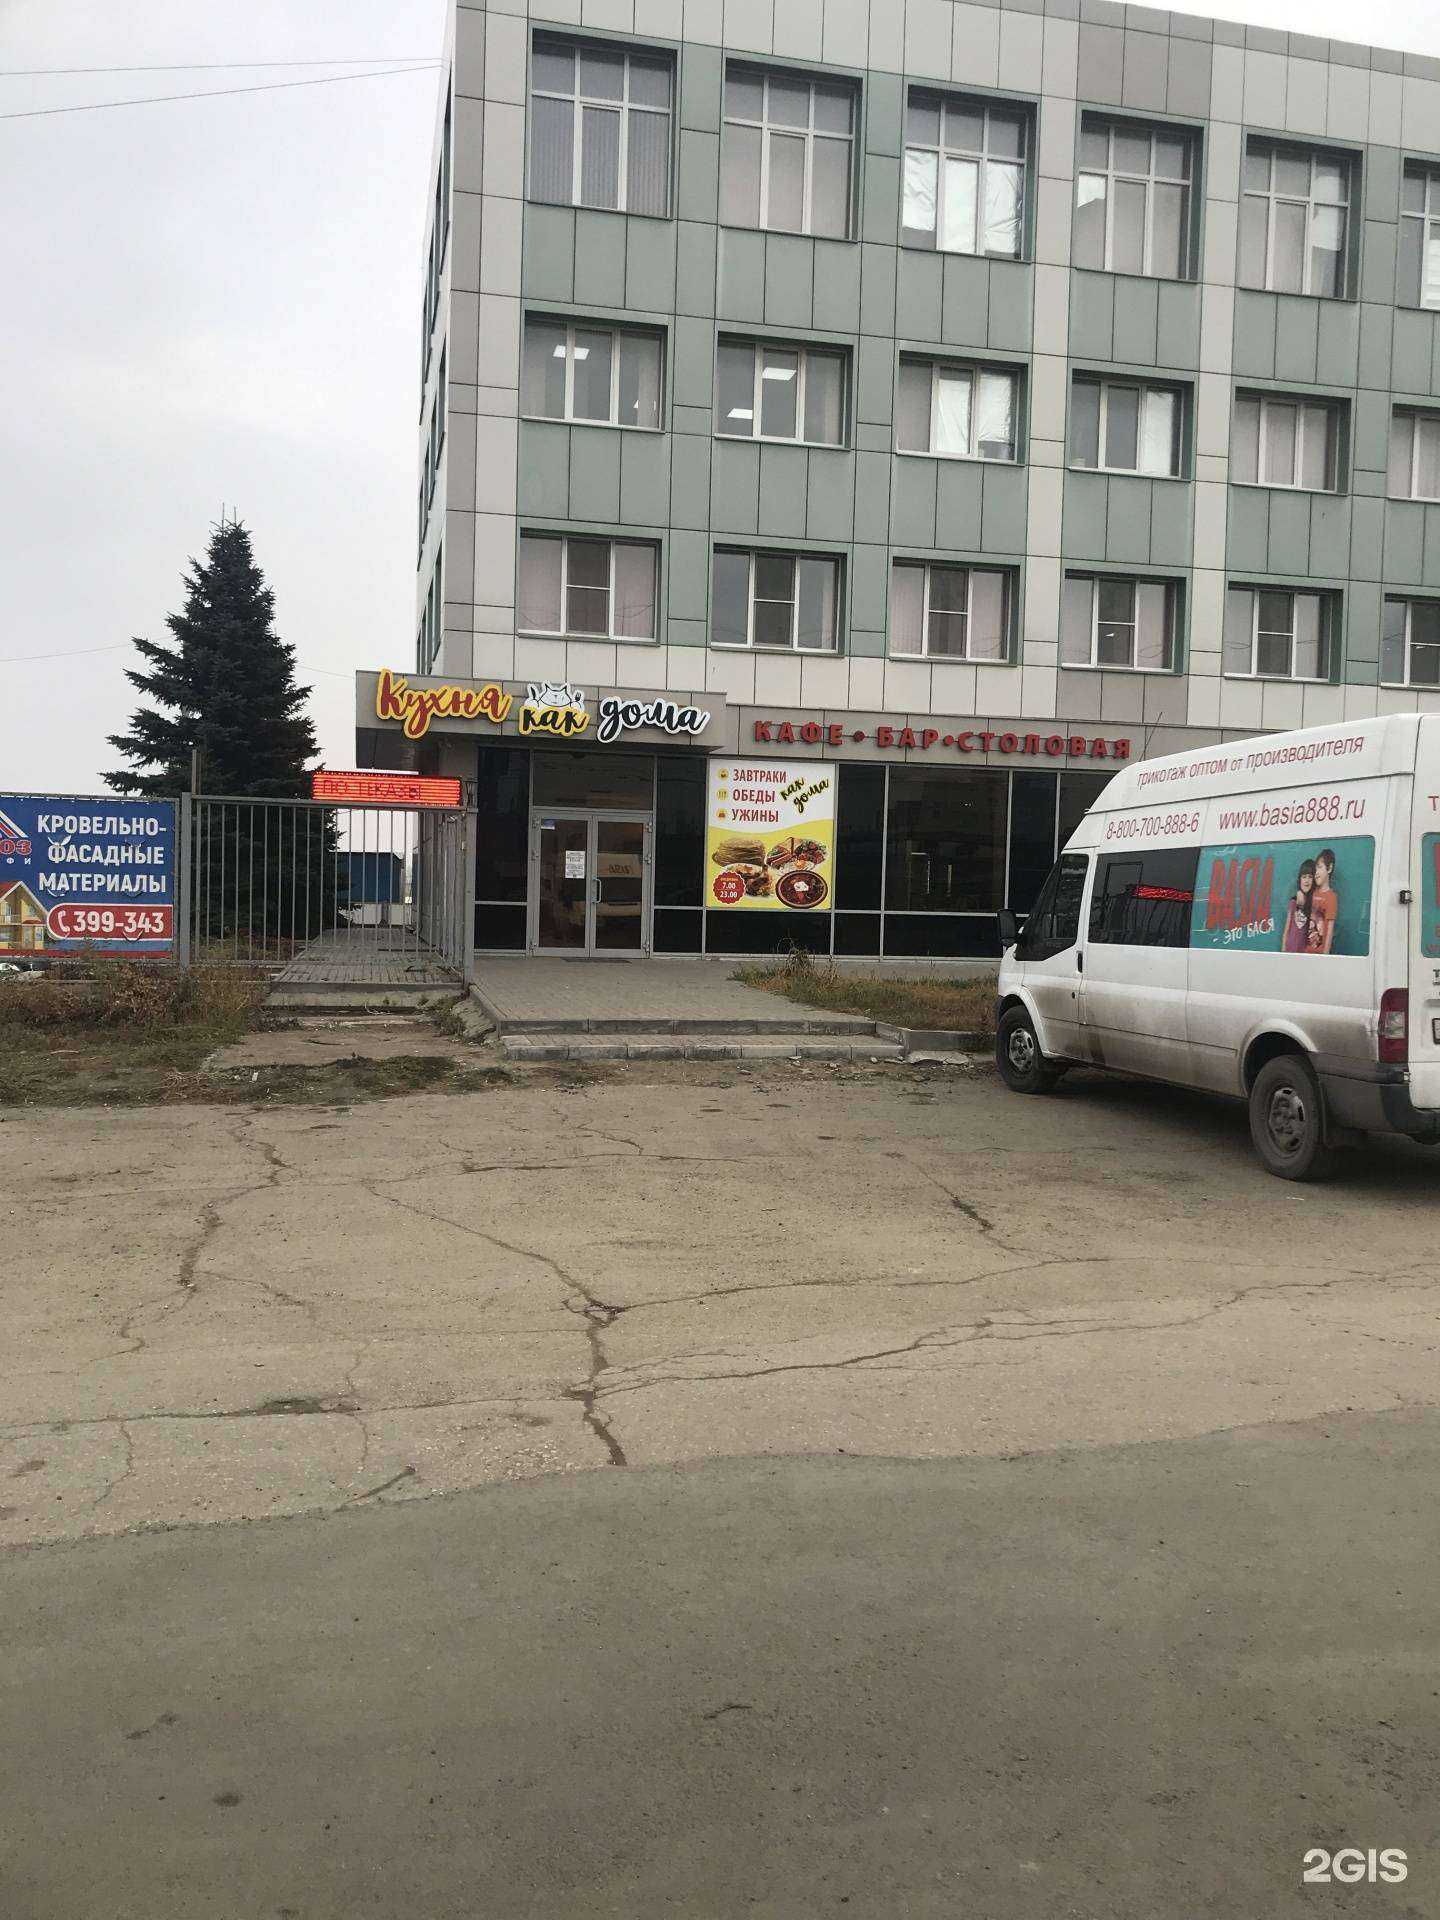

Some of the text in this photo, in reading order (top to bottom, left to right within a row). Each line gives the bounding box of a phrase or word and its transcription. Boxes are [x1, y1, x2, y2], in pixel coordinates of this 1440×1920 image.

[377, 667, 711, 743] Кухня как дома
[755, 719, 1130, 759] КАФЕ БАР СТОЛОВАЯ
[1136, 735, 1365, 789] трикотаж оптом от производителя
[733, 768, 787, 783] ЗАВТРАКИ
[733, 789, 775, 804] ОБЕДЫ
[732, 808, 779, 822] УЖИНЫ
[1219, 795, 1366, 830] www.basia888.ru
[37, 814, 167, 836] КРОВЕЛЬНО-
[1106, 812, 1200, 840] 8-800-700-888-6
[47, 842, 165, 866] ФАСАДНЫЕ
[39, 872, 166, 893] МАТЕРИАЛЫ
[72, 911, 164, 933] 399-343
[1223, 926, 1243, 945] ЭТО
[1246, 917, 1275, 938] БАСЯ
